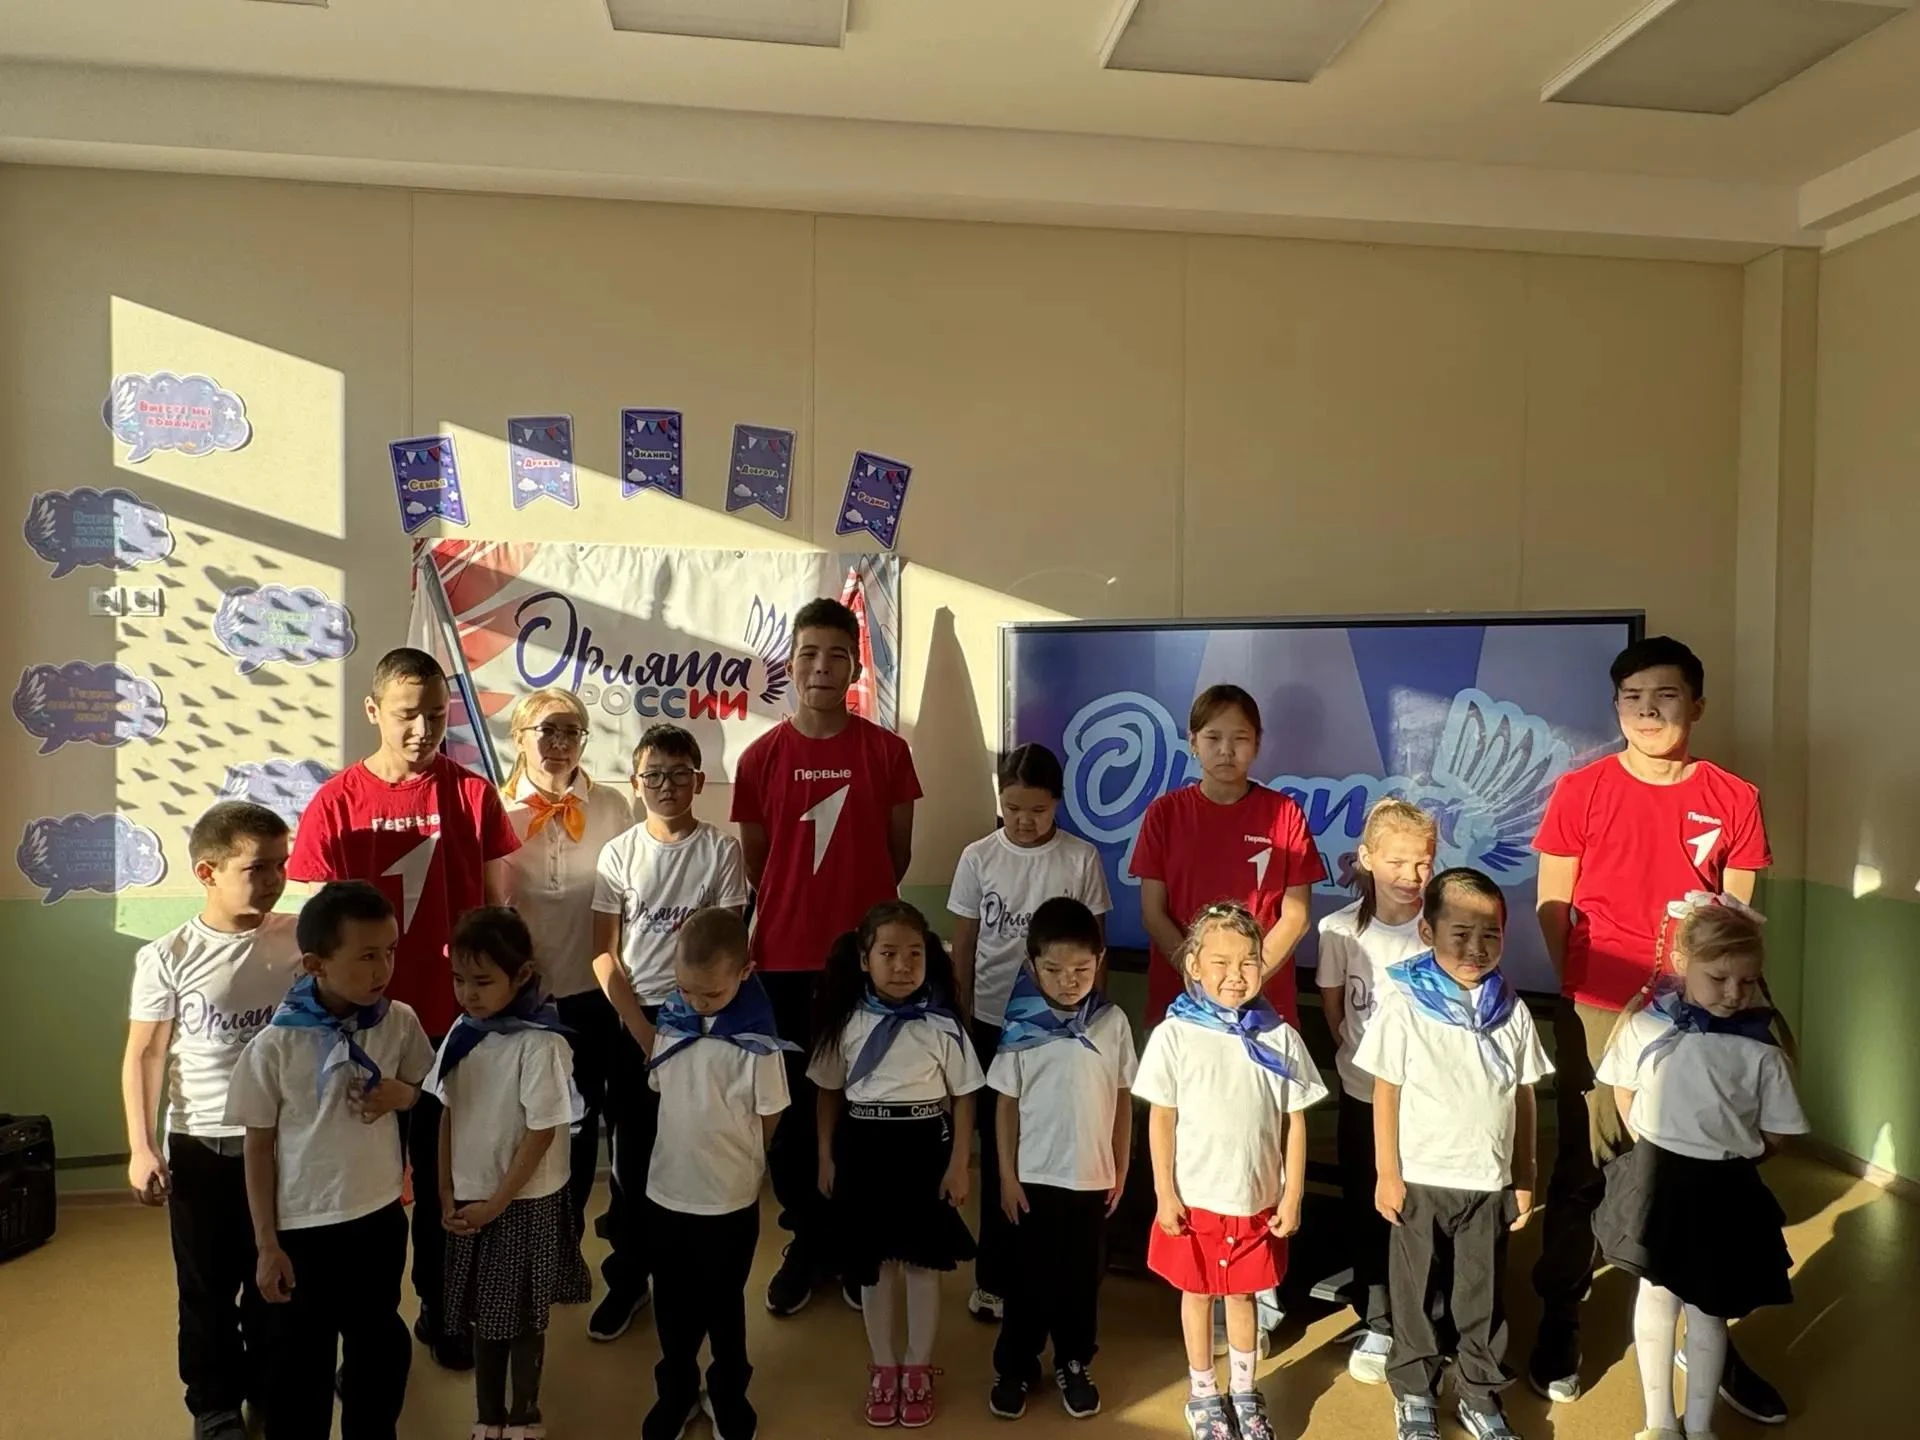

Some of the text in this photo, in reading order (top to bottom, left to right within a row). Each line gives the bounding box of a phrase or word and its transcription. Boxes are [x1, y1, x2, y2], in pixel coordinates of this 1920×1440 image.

[408, 479, 448, 492] Семья
[514, 590, 752, 695] Орлята
[794, 768, 852, 782] Первые
